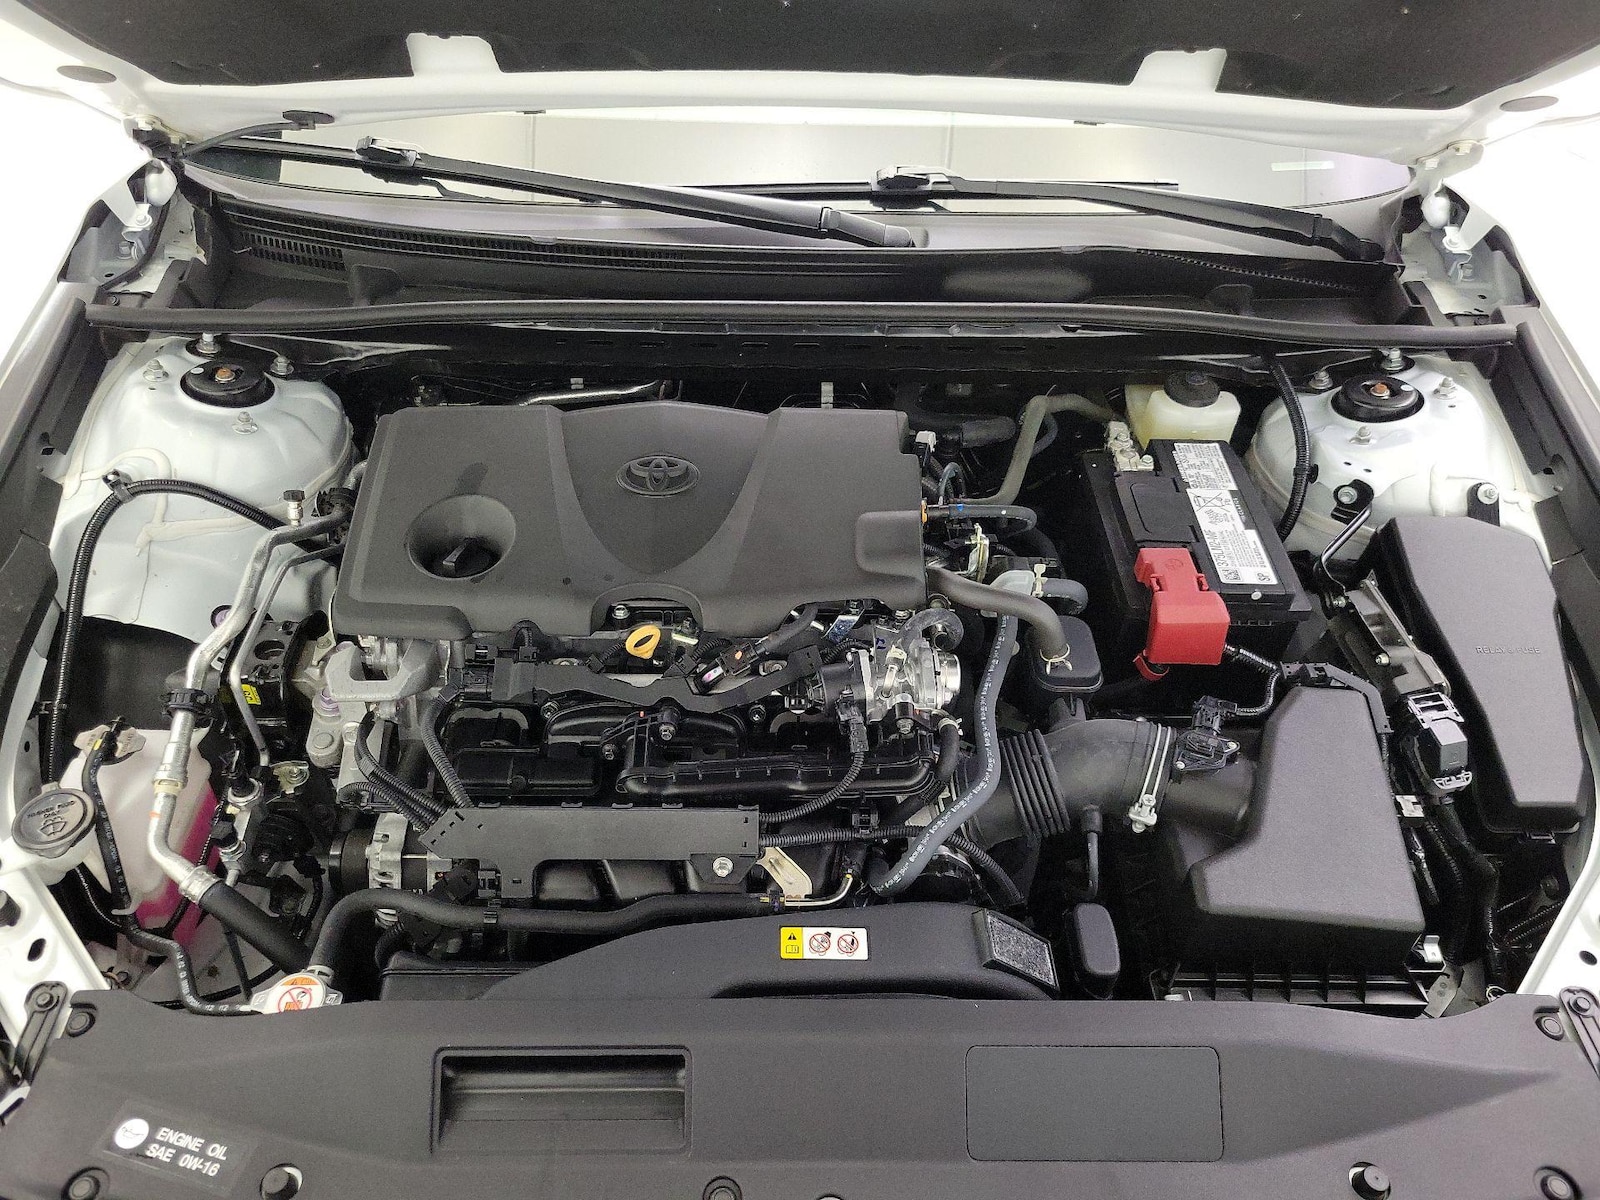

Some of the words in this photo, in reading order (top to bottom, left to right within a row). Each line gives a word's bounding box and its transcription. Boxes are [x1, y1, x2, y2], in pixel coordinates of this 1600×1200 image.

[1475, 646, 1505, 655] RELAY
[145, 1143, 176, 1163] SAE
[178, 1153, 221, 1177] 0W-16
[155, 1126, 205, 1152] ENGINE
[207, 1143, 228, 1161] OIL
